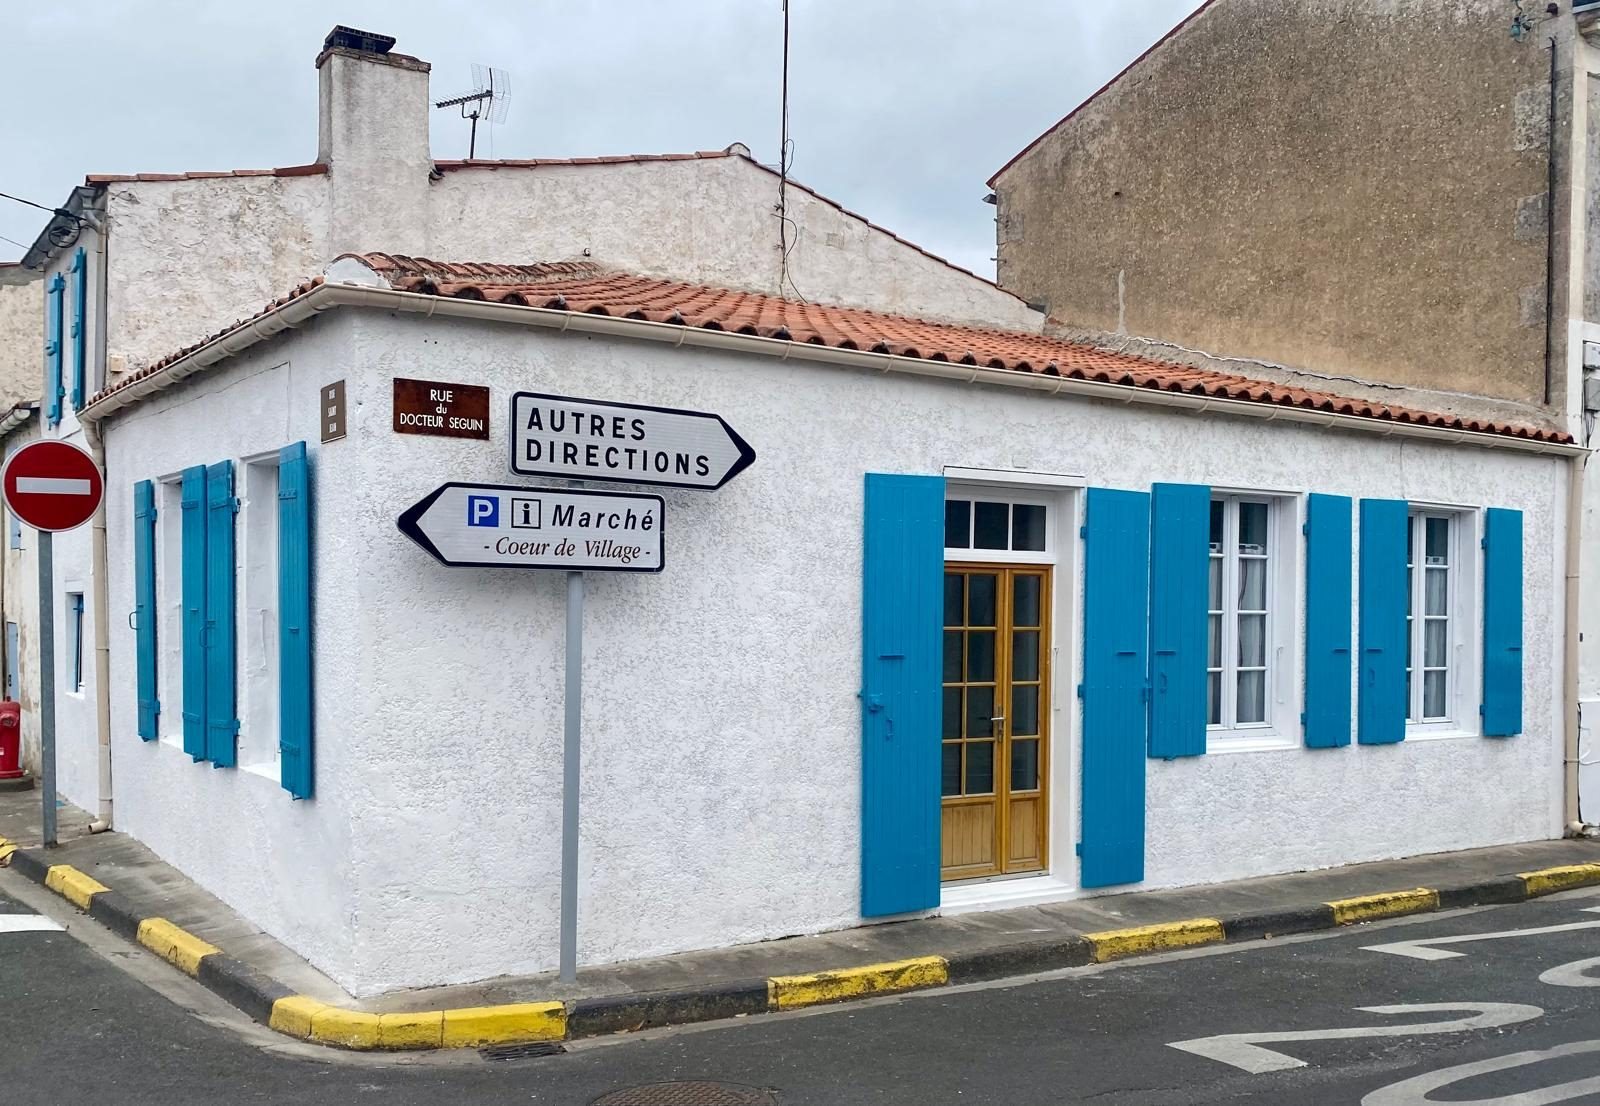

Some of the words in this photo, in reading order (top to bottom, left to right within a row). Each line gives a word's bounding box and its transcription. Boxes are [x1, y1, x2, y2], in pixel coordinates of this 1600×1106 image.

[430, 389, 453, 403] RUE
[435, 403, 448, 414] du
[400, 412, 444, 428] DOCTEUR
[449, 416, 483, 432] SEGUIN
[527, 407, 646, 441] AUTRES
[526, 438, 710, 476] DIRECTIONS
[473, 499, 494, 525] P
[552, 504, 653, 531] Marché
[495, 537, 550, 556] Coeur
[554, 538, 576, 557] de
[585, 540, 641, 563] Village
